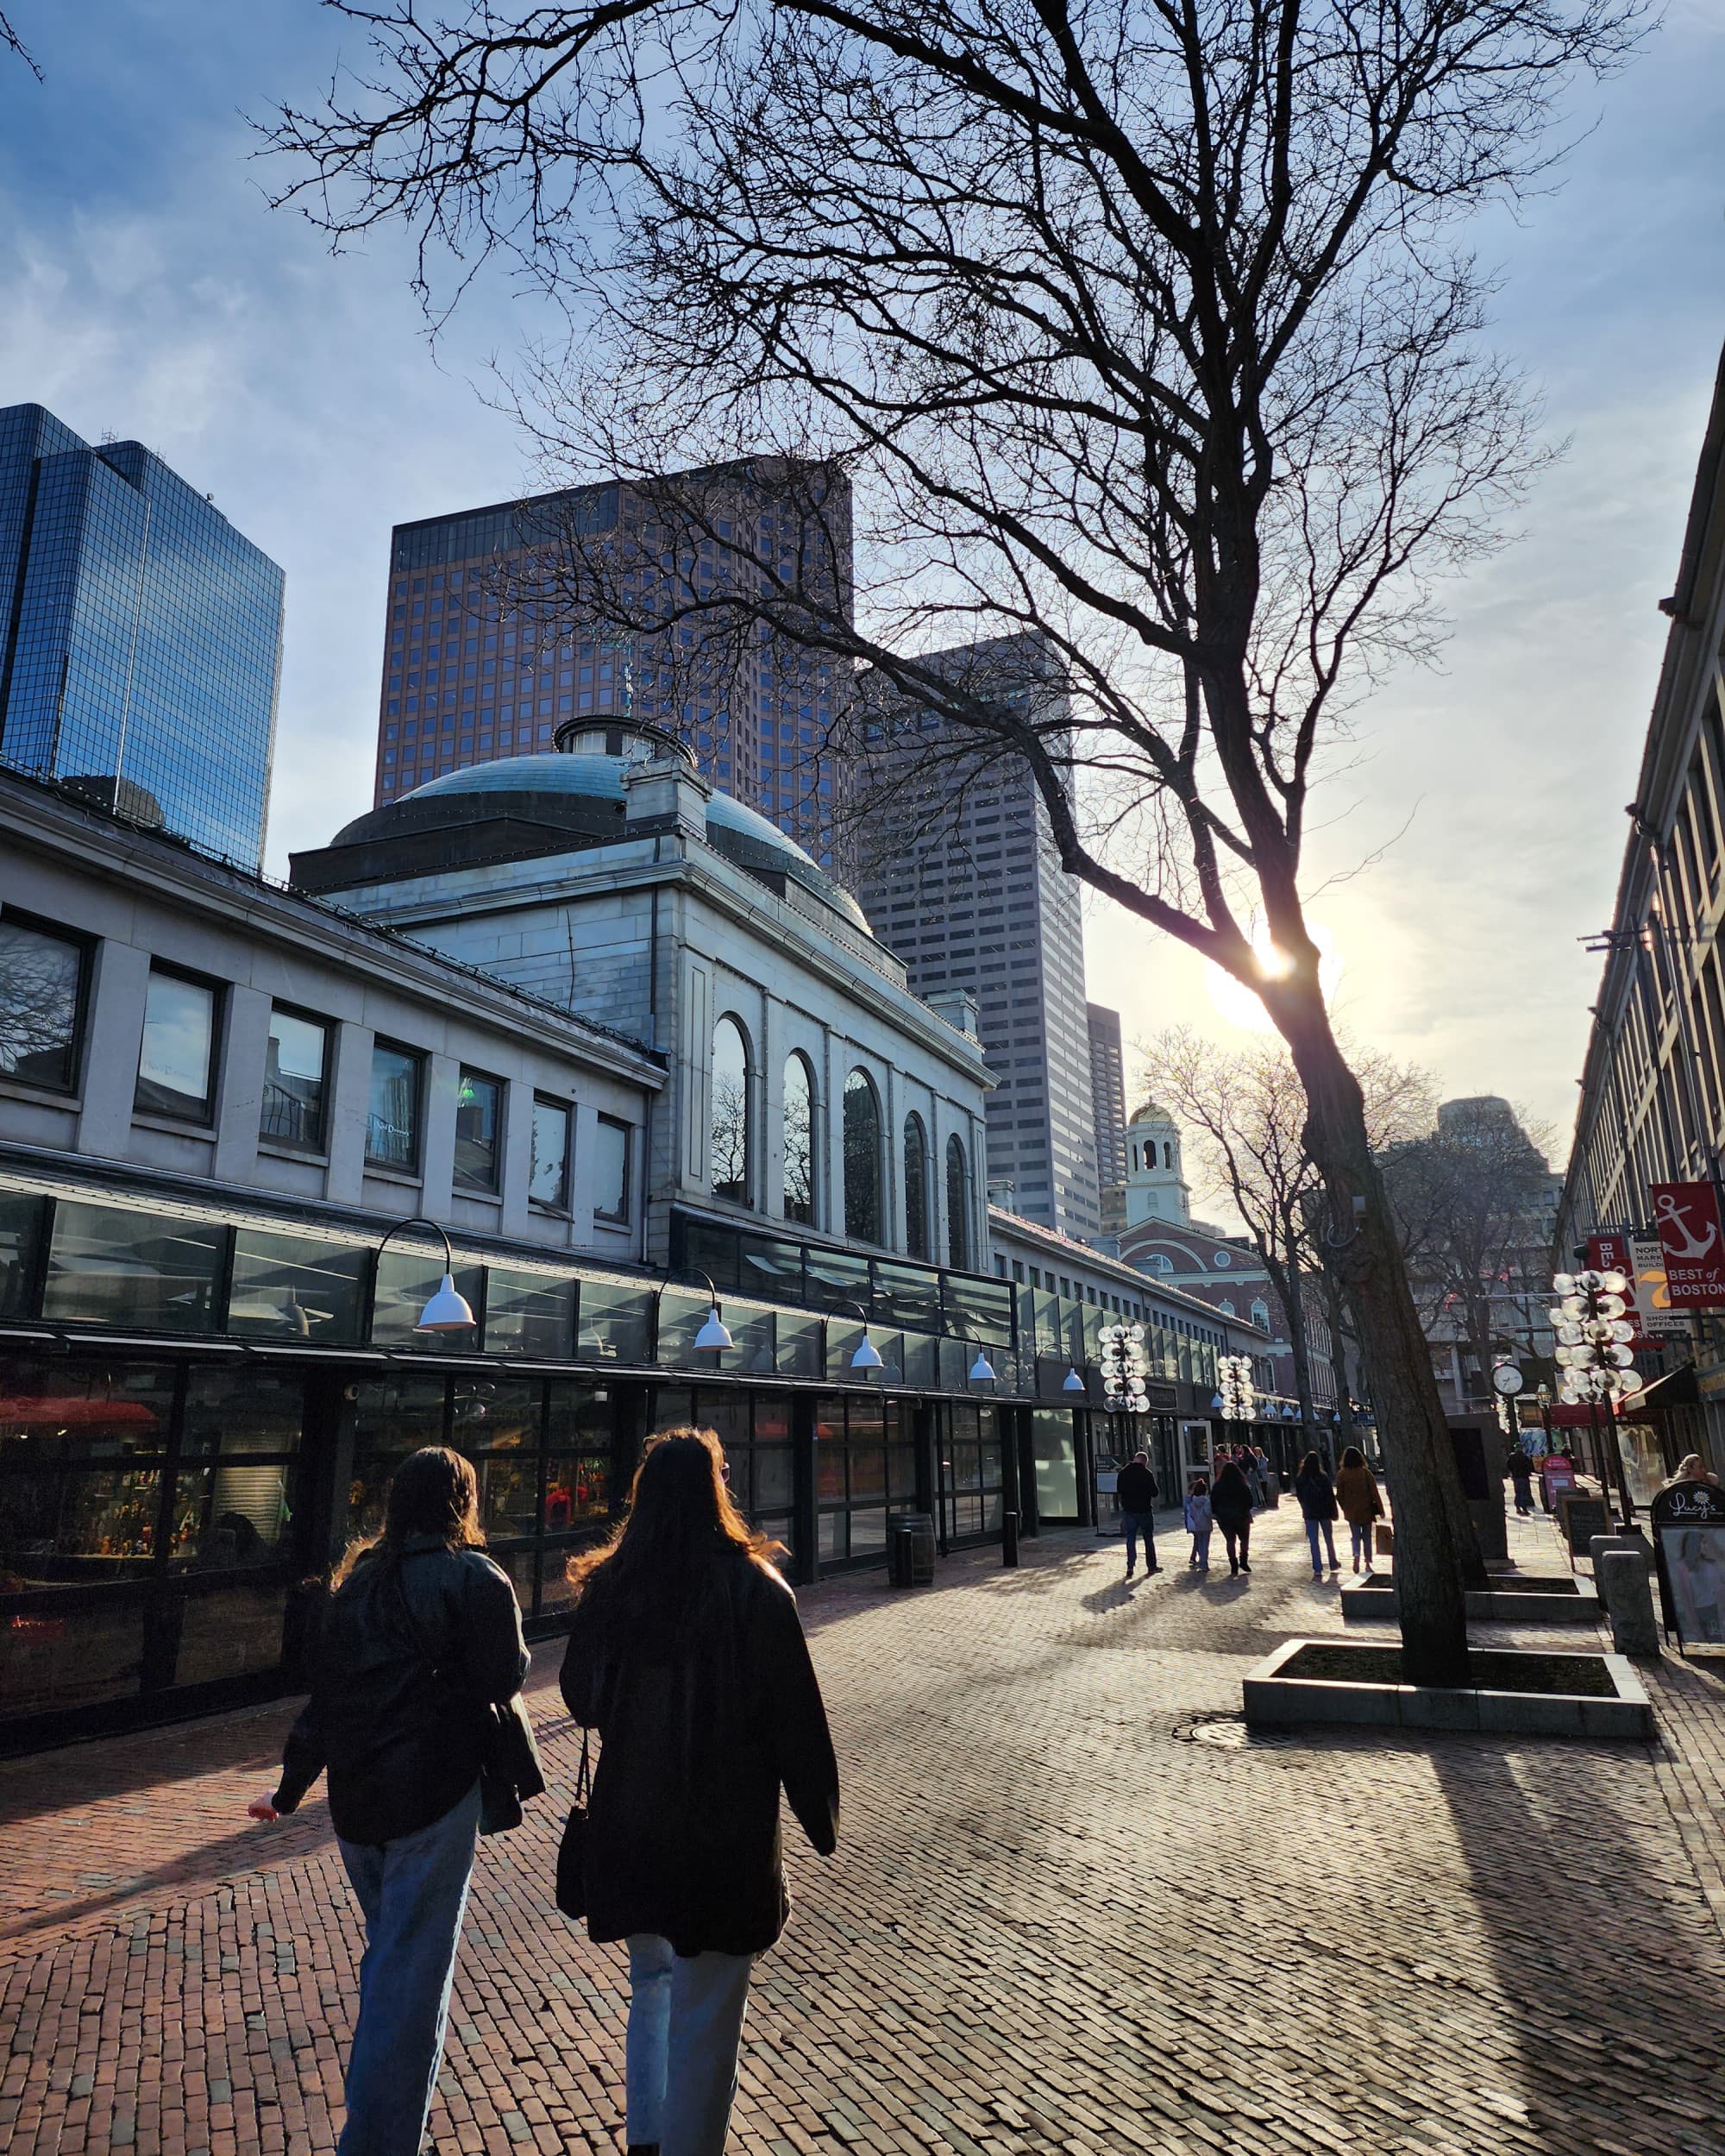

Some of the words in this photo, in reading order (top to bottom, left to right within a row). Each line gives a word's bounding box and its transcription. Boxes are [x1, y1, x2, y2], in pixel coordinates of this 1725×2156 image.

[1669, 1269, 1703, 1280] BEST
[1706, 1267, 1720, 1282] of
[1672, 1283, 1725, 1296] BOSTON
[1669, 1492, 1717, 1520] Lucy's
